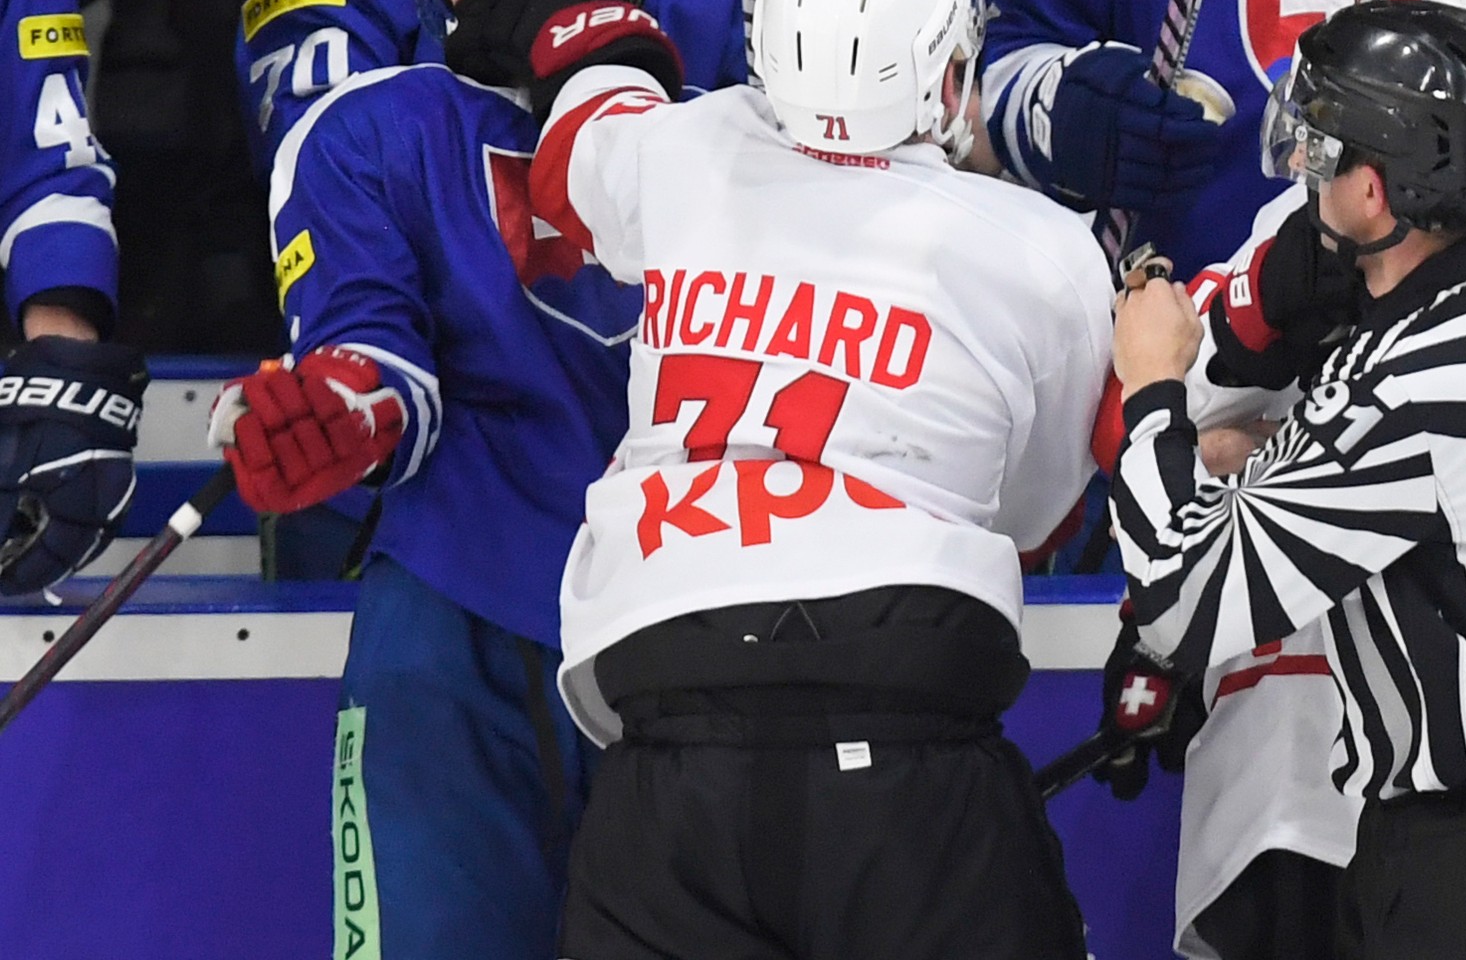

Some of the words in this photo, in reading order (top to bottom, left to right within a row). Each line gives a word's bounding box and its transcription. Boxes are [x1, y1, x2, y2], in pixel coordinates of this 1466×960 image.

[30, 26, 86, 46] FORT
[549, 5, 662, 49] UER
[927, 0, 958, 57] BAUER
[250, 27, 350, 133] 70
[815, 114, 851, 141] 71
[643, 269, 933, 391] RICHARD
[651, 353, 851, 466] 71
[1303, 379, 1385, 455] 91
